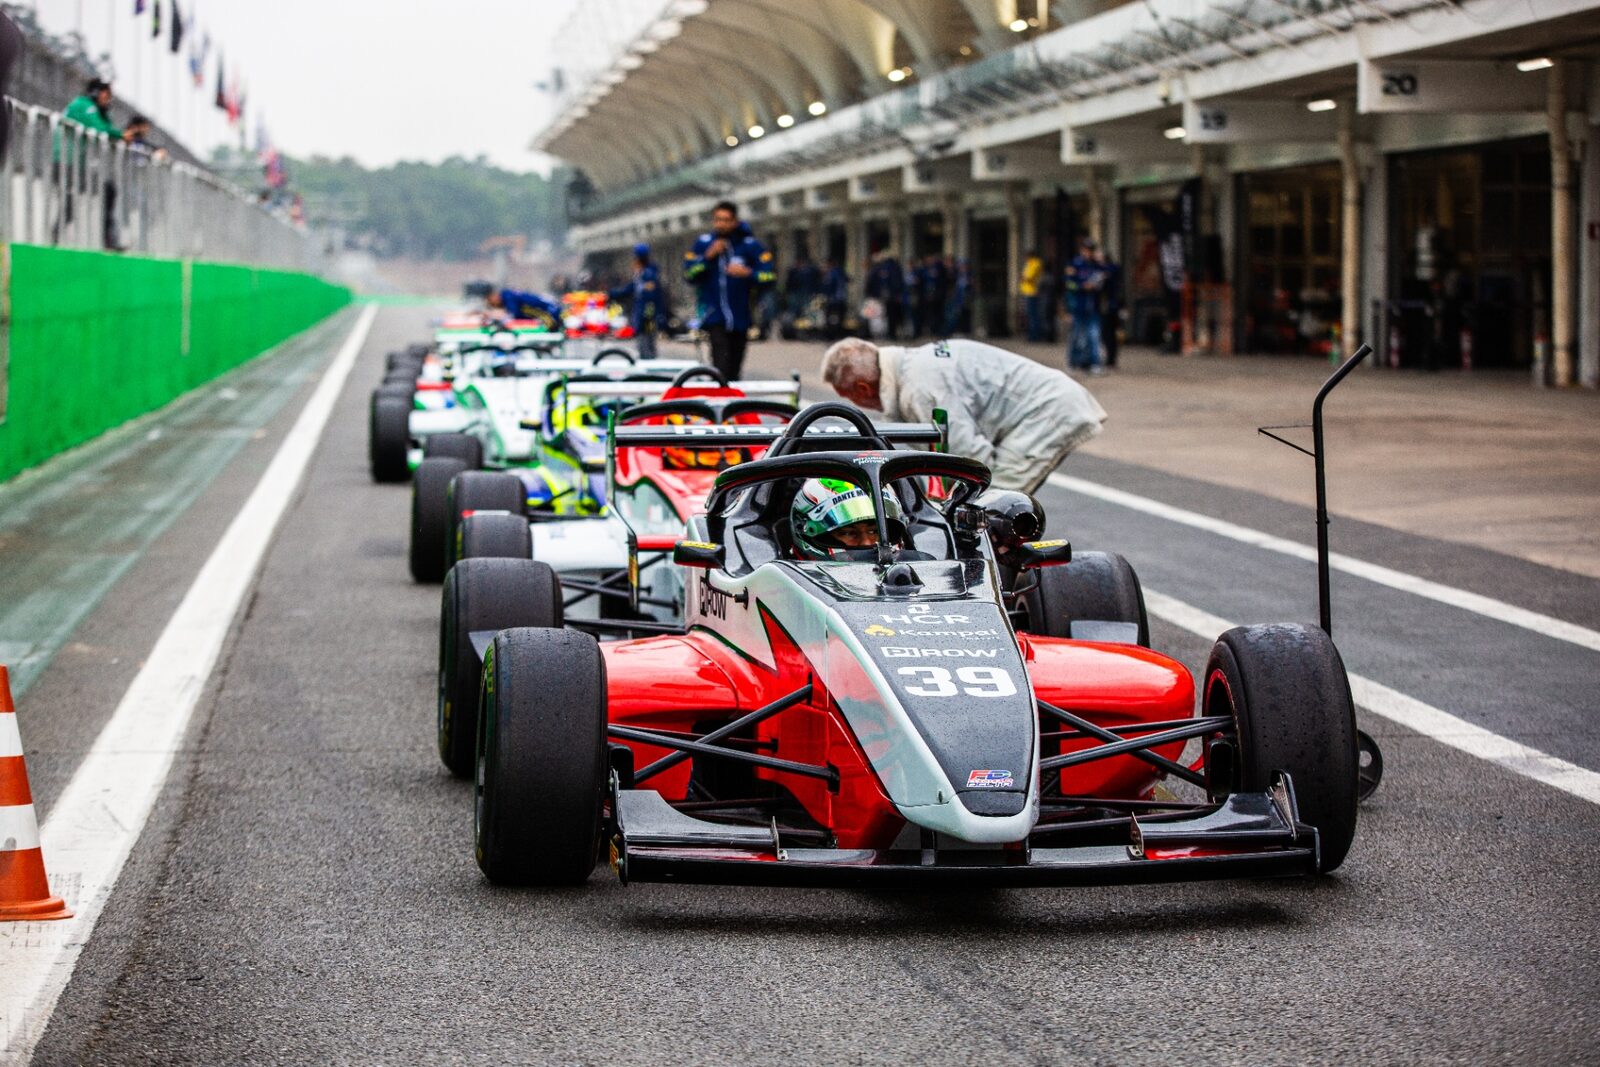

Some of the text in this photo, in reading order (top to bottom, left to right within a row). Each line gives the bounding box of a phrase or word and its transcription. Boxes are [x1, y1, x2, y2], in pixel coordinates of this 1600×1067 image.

[1382, 74, 1418, 97] 20
[832, 490, 856, 505] DANTE
[880, 614, 972, 624] HCR
[899, 628, 998, 638] Kampai
[897, 666, 1018, 698] 39
